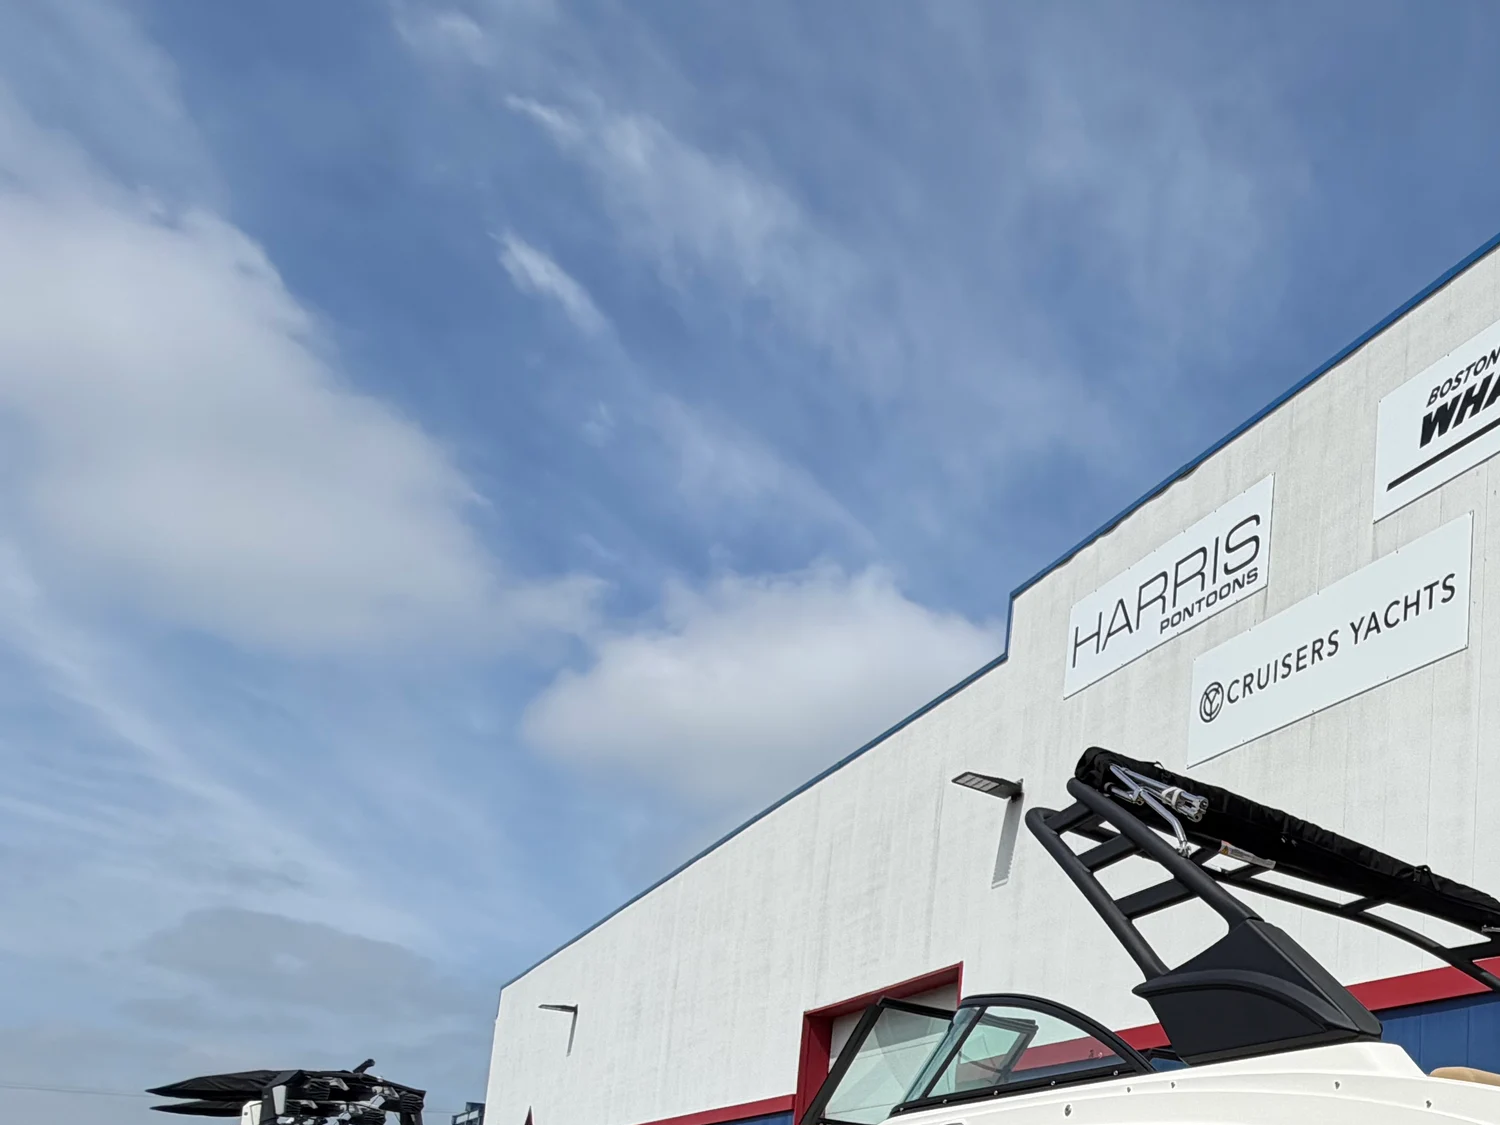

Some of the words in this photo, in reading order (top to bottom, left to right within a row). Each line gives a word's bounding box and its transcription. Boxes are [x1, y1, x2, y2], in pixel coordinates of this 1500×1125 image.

[1072, 514, 1261, 668] HARRIS
[1160, 567, 1259, 634] PONTOONS
[1226, 629, 1339, 704] CRUISERS
[1349, 573, 1456, 645] YACHTS
